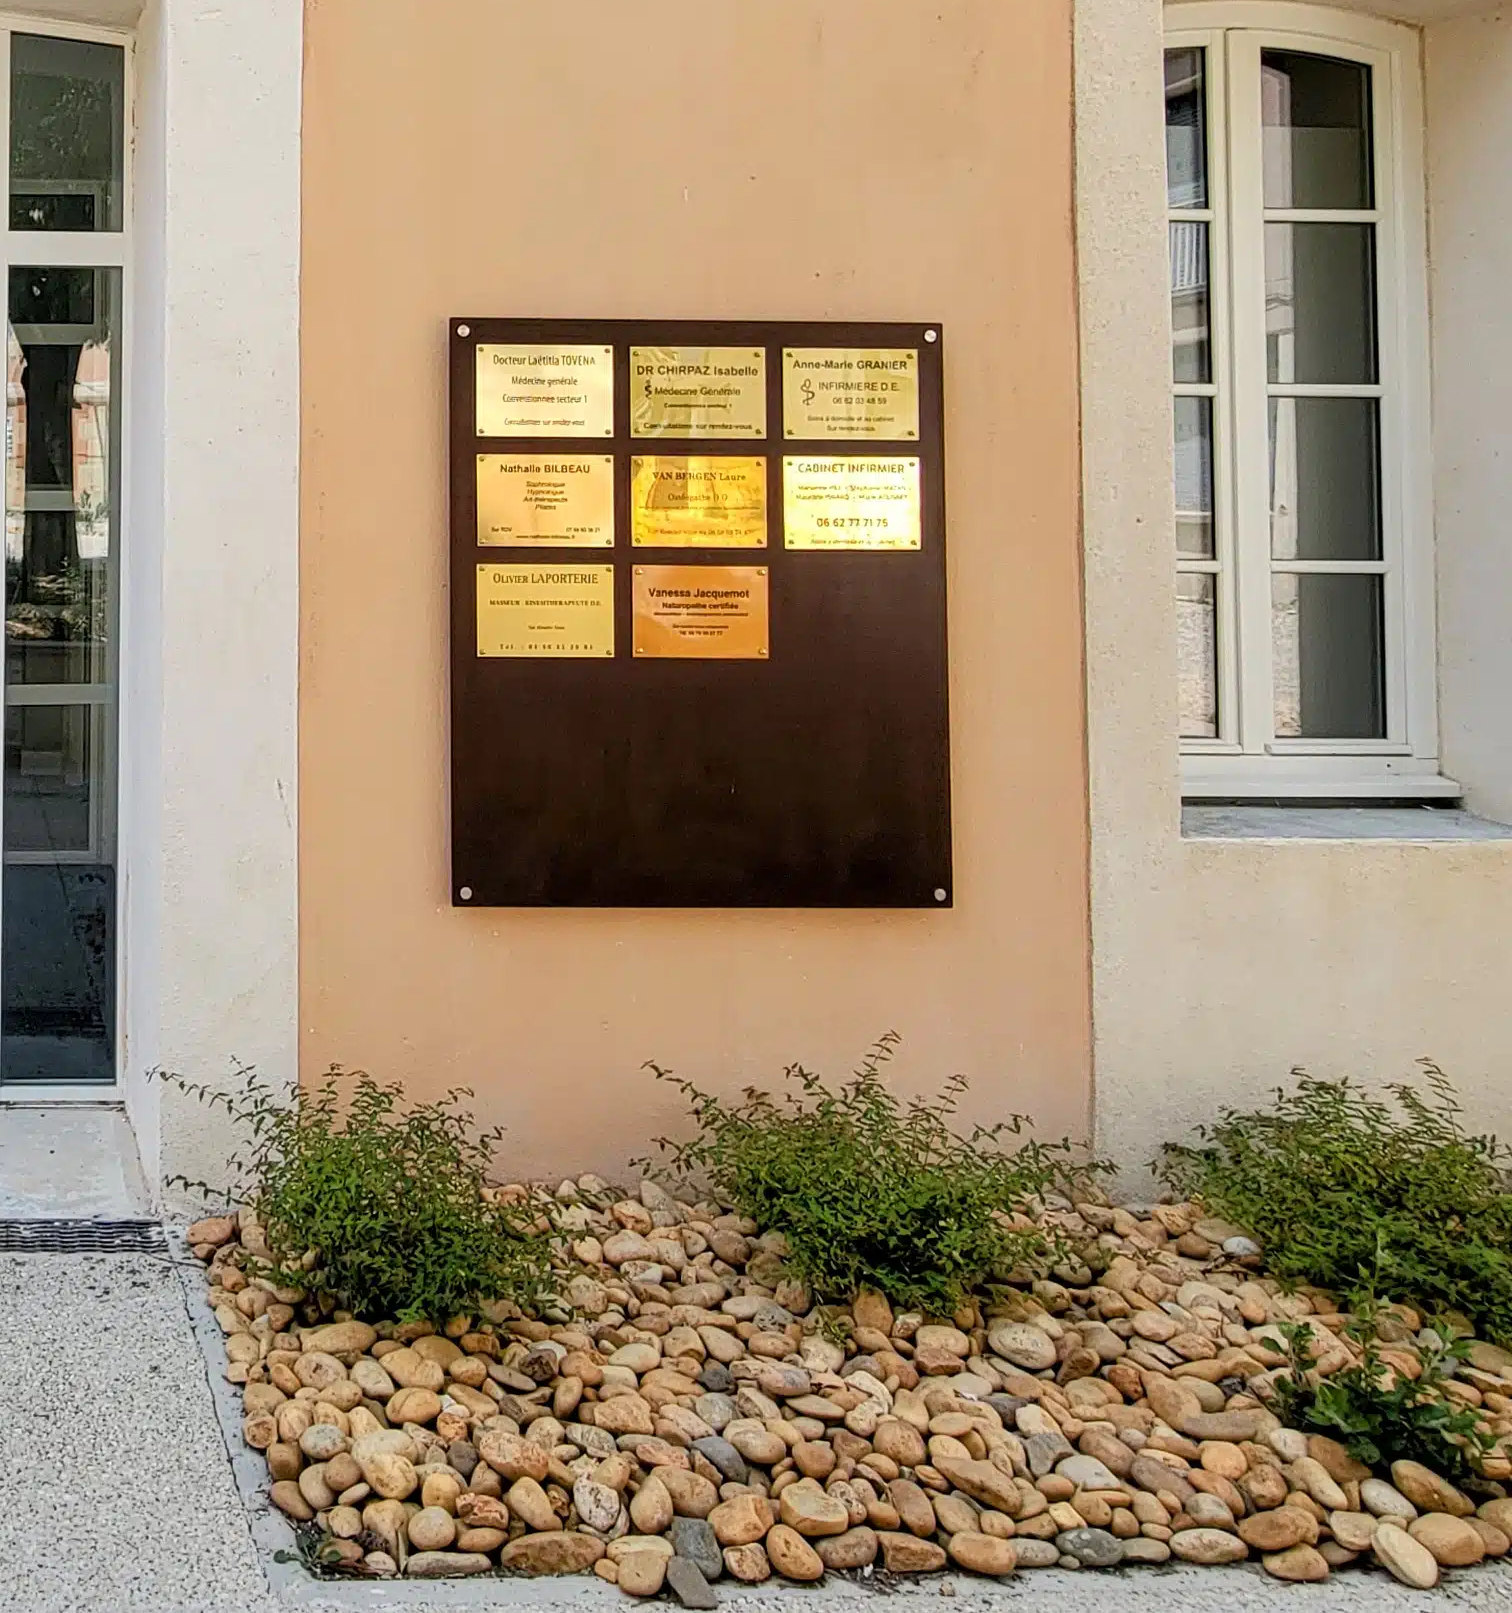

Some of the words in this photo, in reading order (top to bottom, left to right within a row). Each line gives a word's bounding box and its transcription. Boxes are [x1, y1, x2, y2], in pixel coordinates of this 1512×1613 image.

[493, 354, 526, 366] Docteur
[561, 355, 596, 366] TOVENA
[793, 359, 853, 369] Anne-Marie
[856, 360, 907, 370] GRANIER
[636, 365, 654, 375] DR
[657, 365, 711, 376] CHIRPAZ
[714, 366, 758, 376] Isabelle
[818, 381, 878, 391] INFIRMIERE
[556, 395, 582, 403] secteur
[500, 464, 541, 473] Nathalie
[544, 464, 591, 474] BILBEAU
[798, 463, 845, 473] CABINET
[848, 463, 905, 473] INFIRMIER
[652, 472, 673, 481] VAN
[719, 472, 746, 481] Laure
[816, 518, 830, 527] 06
[832, 518, 845, 527] 62
[849, 518, 860, 527] 77
[877, 518, 888, 527] 75
[531, 573, 599, 584] LAPORTERIE
[648, 588, 691, 598] Vanessa
[693, 588, 750, 600] Jacquemot
